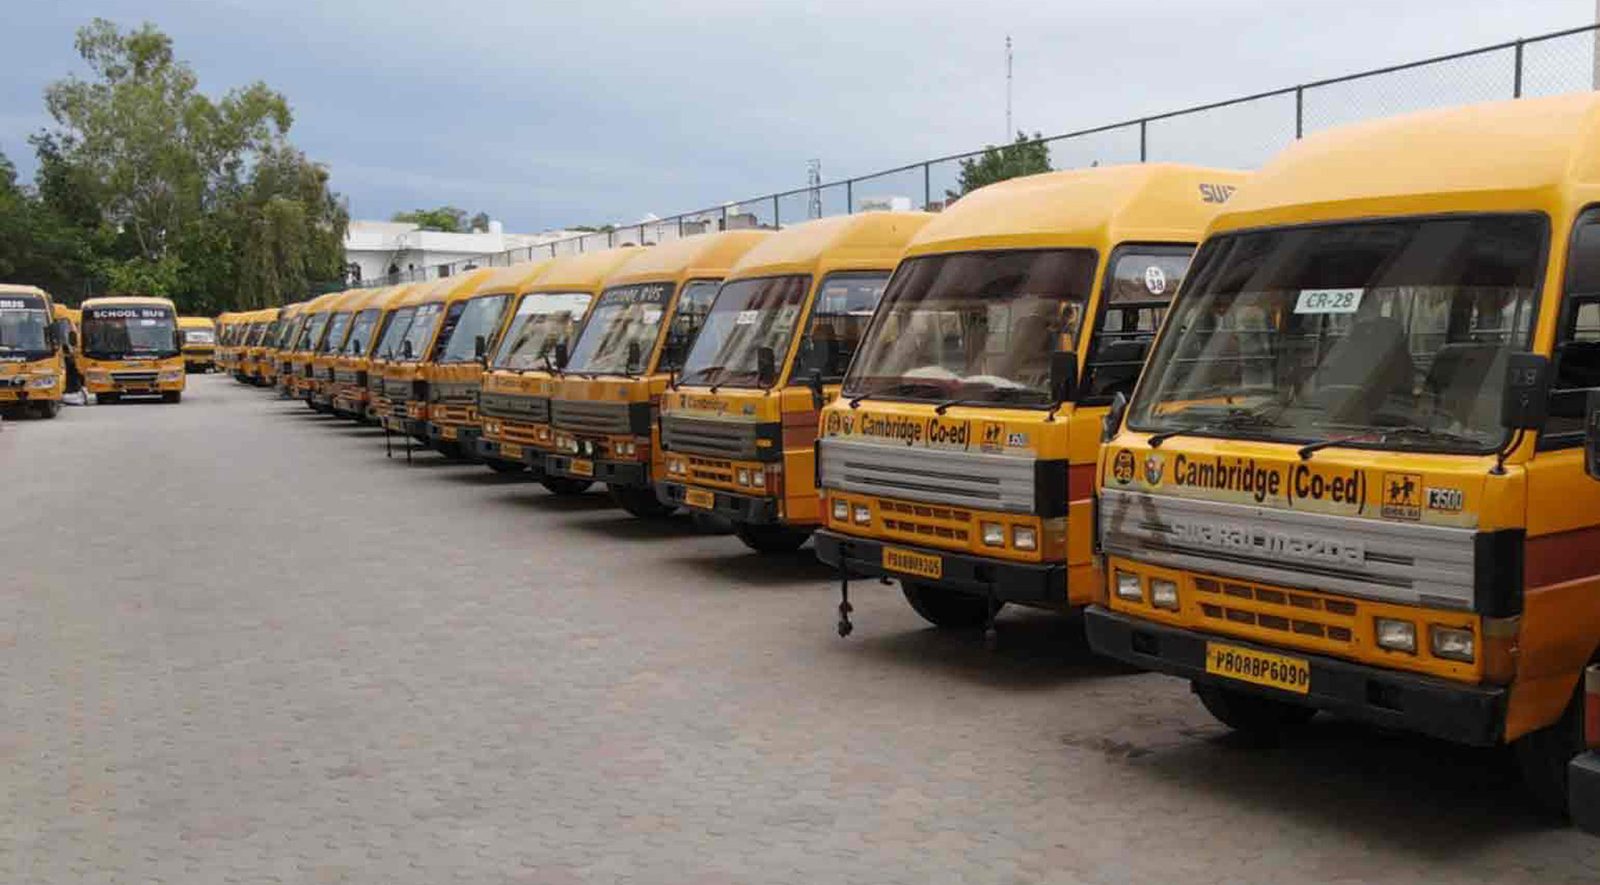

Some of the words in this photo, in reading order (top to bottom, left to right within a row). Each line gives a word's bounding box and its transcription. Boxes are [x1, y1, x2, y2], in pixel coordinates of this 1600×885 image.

[1149, 279, 1163, 291] 38
[1306, 291, 1354, 308] CR-28
[93, 309, 139, 318] SCHOOL
[142, 309, 165, 318] BUS
[861, 413, 921, 446] Cambridge
[925, 416, 971, 452] (Co-ed)
[1116, 466, 1131, 480] 28
[1174, 453, 1280, 502] Cambridge
[1286, 463, 1367, 515] (Co-ed)
[1215, 649, 1307, 686] PB08BP6090
